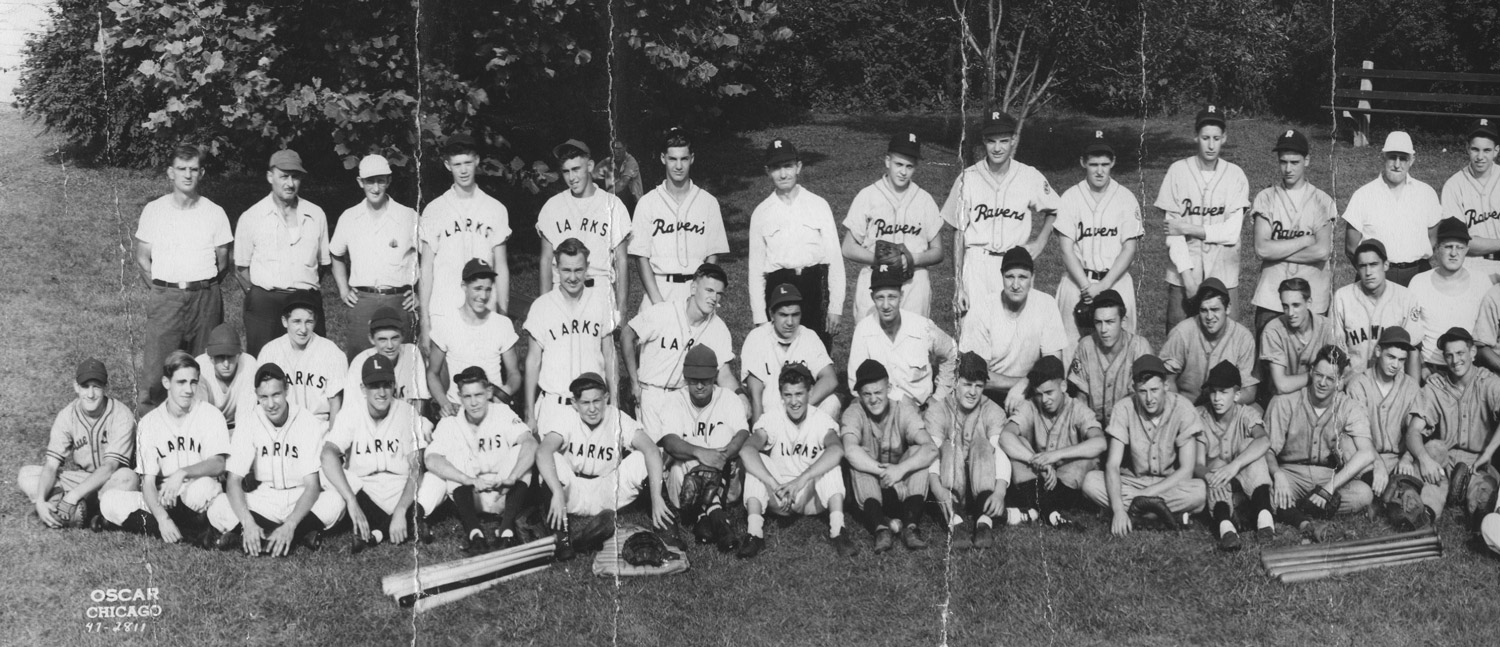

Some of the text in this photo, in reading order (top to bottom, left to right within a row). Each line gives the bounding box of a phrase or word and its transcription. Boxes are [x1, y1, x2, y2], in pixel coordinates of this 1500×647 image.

[1208, 105, 1216, 113] R
[992, 111, 1000, 120] R
[1480, 118, 1488, 126] R
[909, 133, 916, 142] R
[1095, 130, 1103, 138] R
[1285, 129, 1294, 138] R
[774, 140, 782, 148] R
[974, 204, 1025, 222] Ravens
[556, 217, 607, 236] LARKS
[661, 337, 694, 350] LAR
[374, 359, 382, 369] L
[281, 371, 326, 388] ARKS
[568, 442, 612, 461] LARKS
